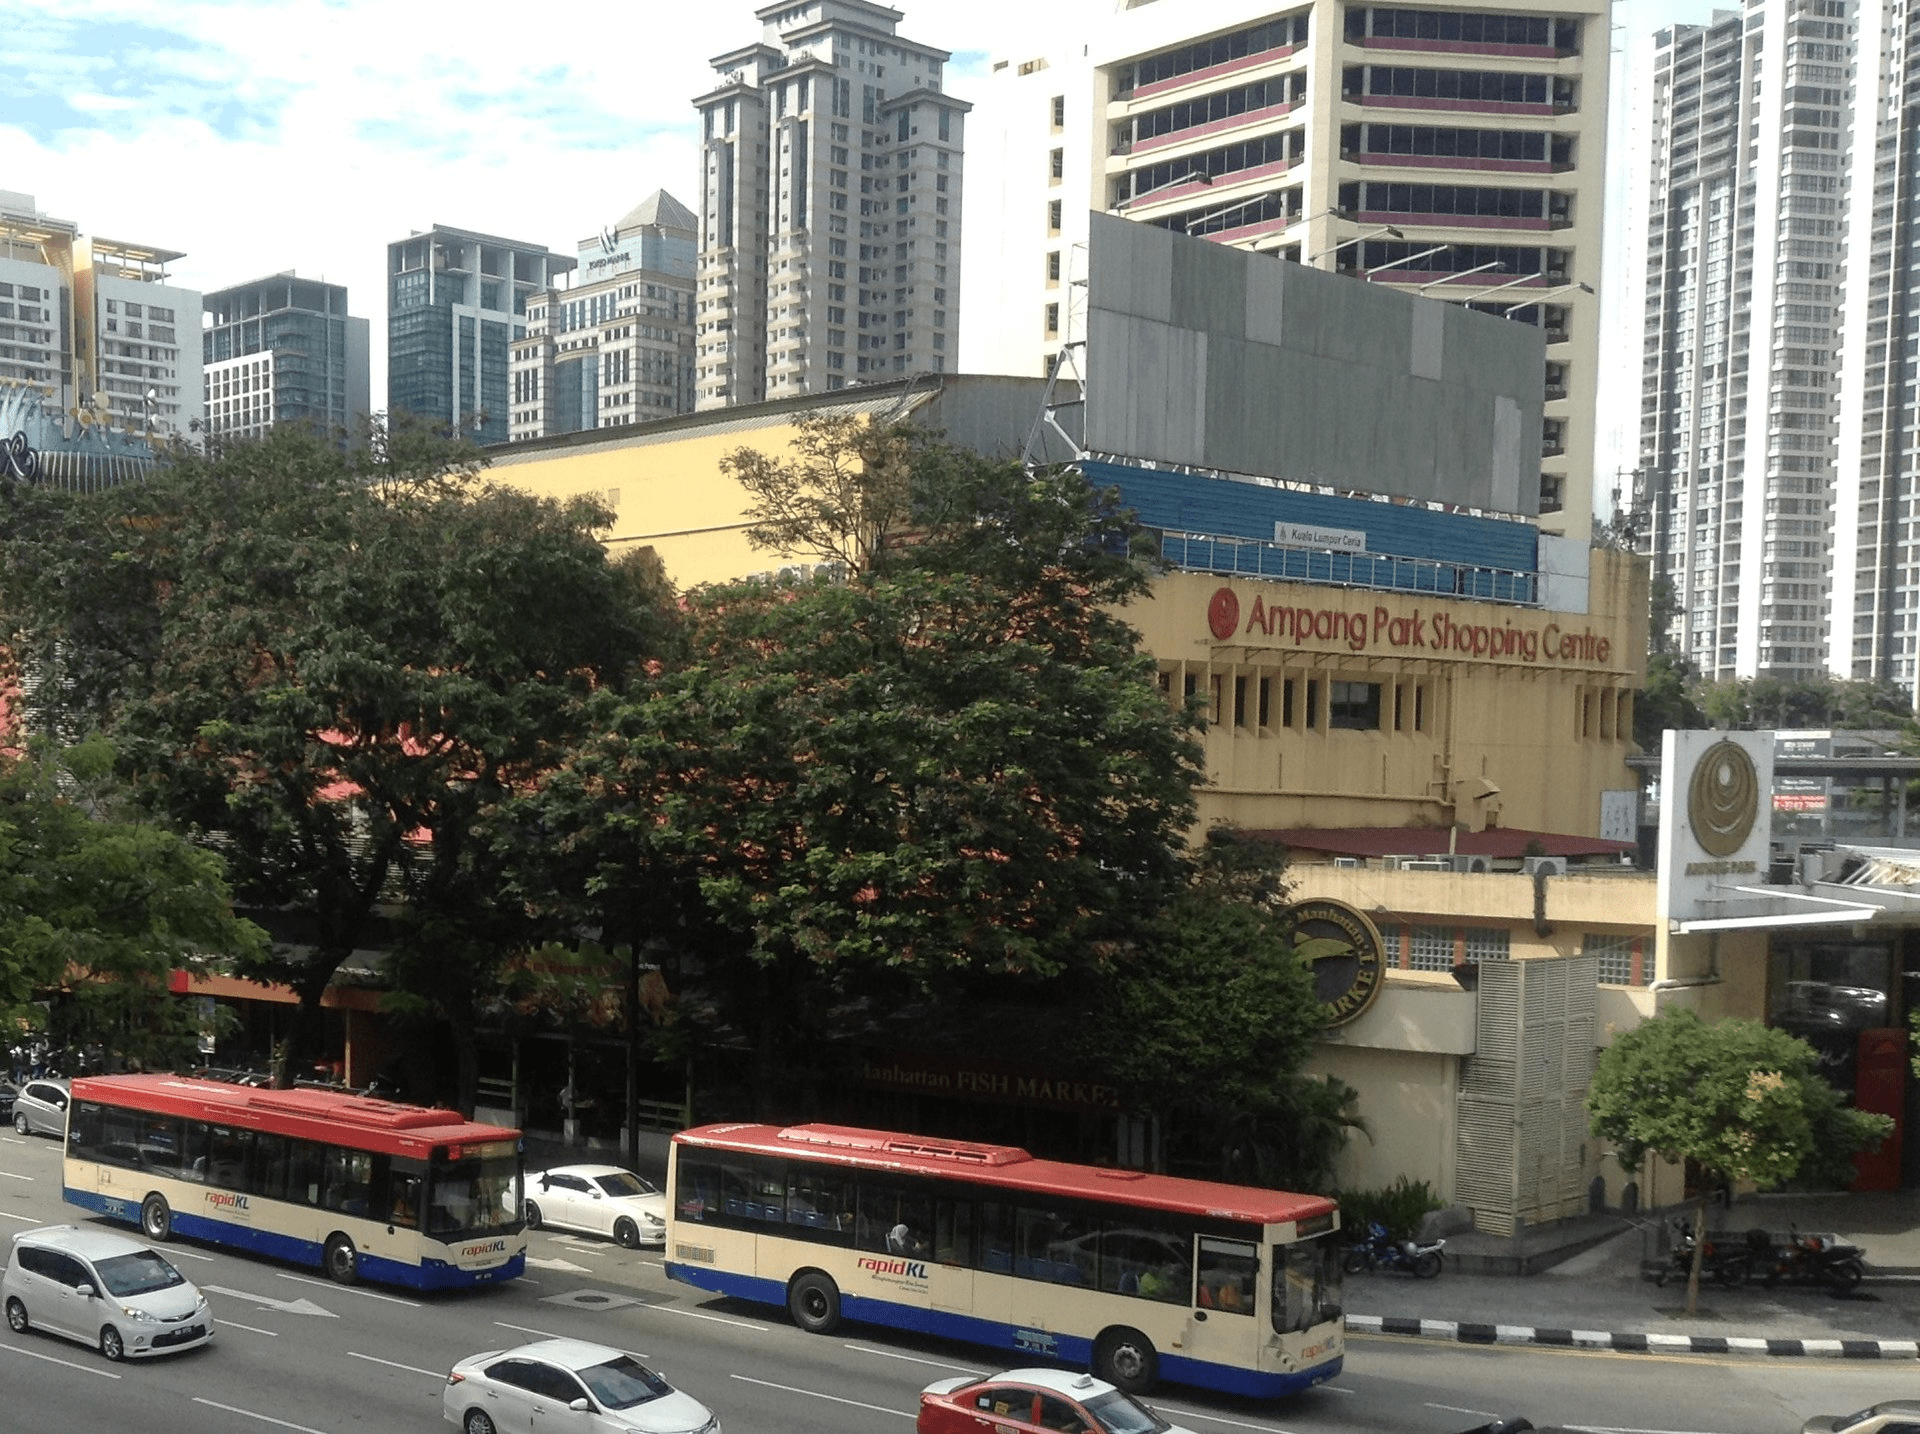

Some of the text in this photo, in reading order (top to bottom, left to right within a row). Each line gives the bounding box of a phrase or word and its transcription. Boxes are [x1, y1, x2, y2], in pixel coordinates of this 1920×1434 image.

[1291, 528, 1313, 542] Kuala
[1313, 531, 1342, 546] Lumpur
[1246, 594, 1611, 663] Ampang Park Shopping Centre
[1297, 908, 1365, 945] Manhattan
[956, 1070, 1009, 1095] FISH
[204, 1191, 250, 1210] rapidKL
[461, 1240, 506, 1256] rapidKL
[857, 1257, 929, 1280] rapidKL
[1301, 1336, 1335, 1360] rapidKL
